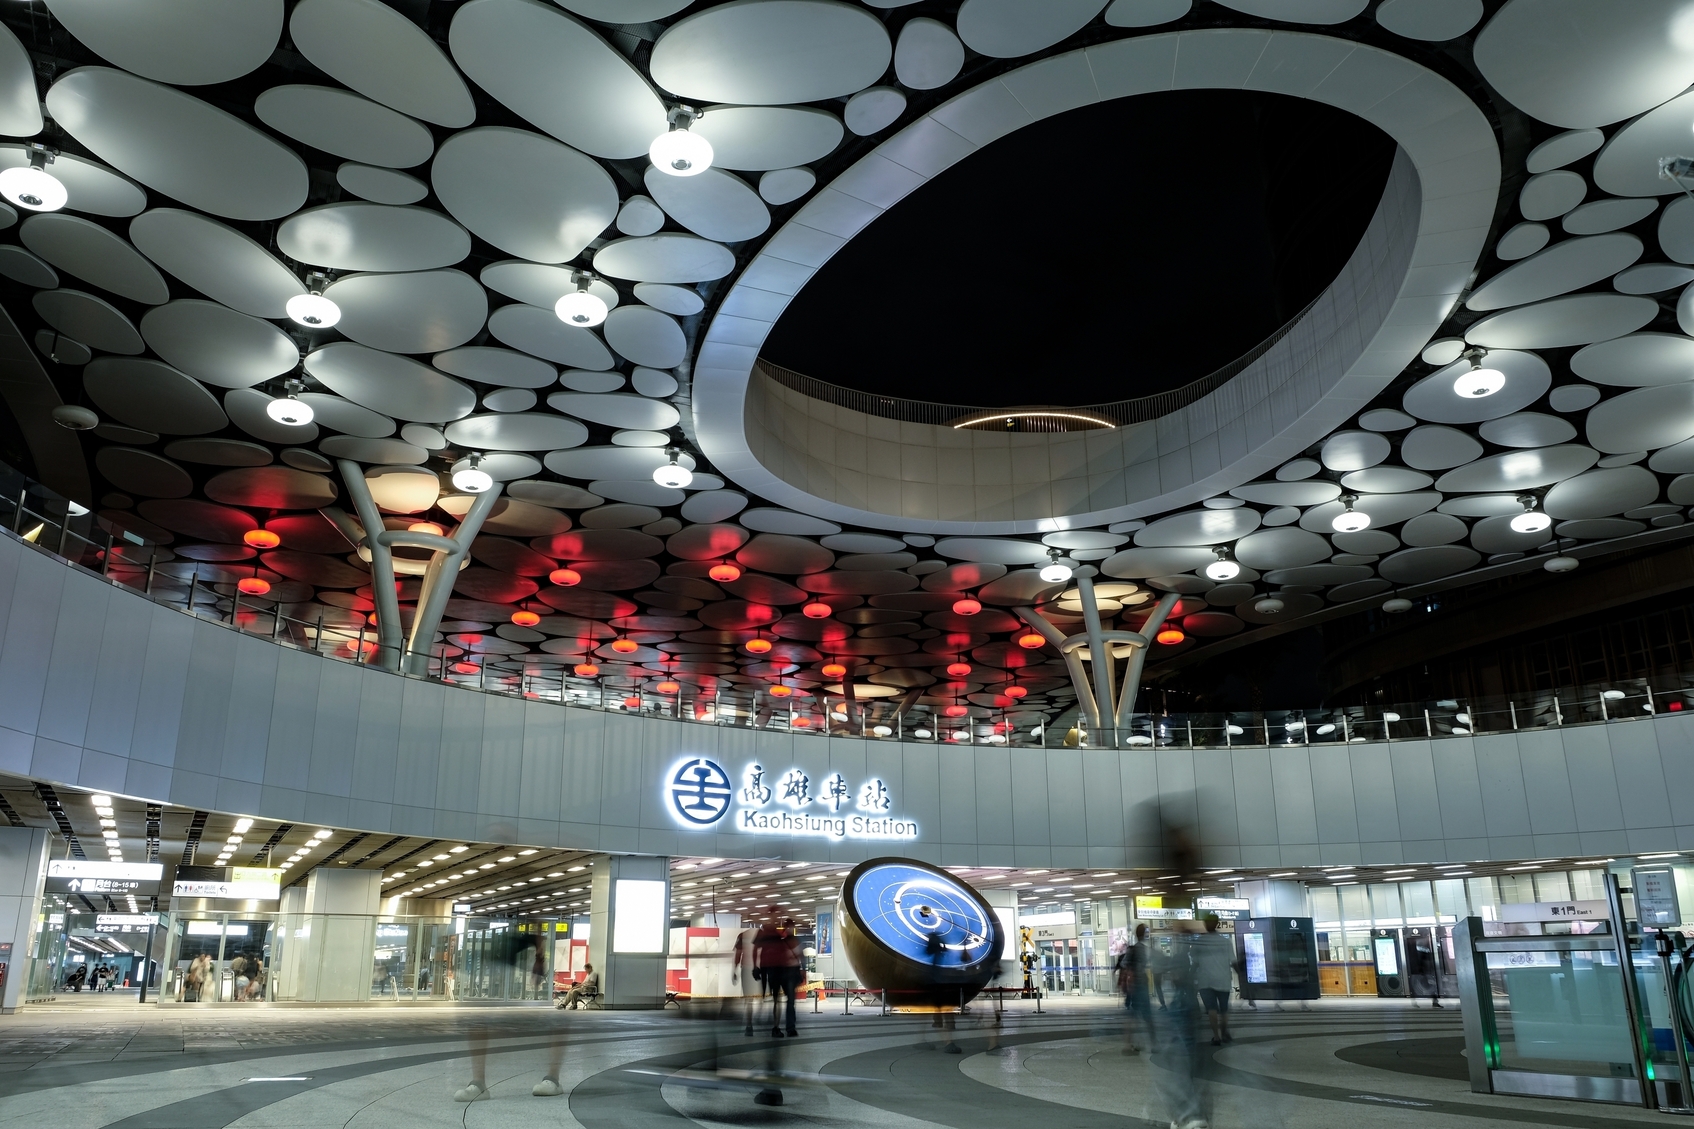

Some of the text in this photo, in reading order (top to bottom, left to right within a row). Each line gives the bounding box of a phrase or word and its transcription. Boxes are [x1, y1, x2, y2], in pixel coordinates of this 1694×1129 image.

[742, 764, 890, 811] 高雄車站
[743, 811, 918, 836] Kaohsiung Station
[1551, 905, 1576, 916] 東1門
